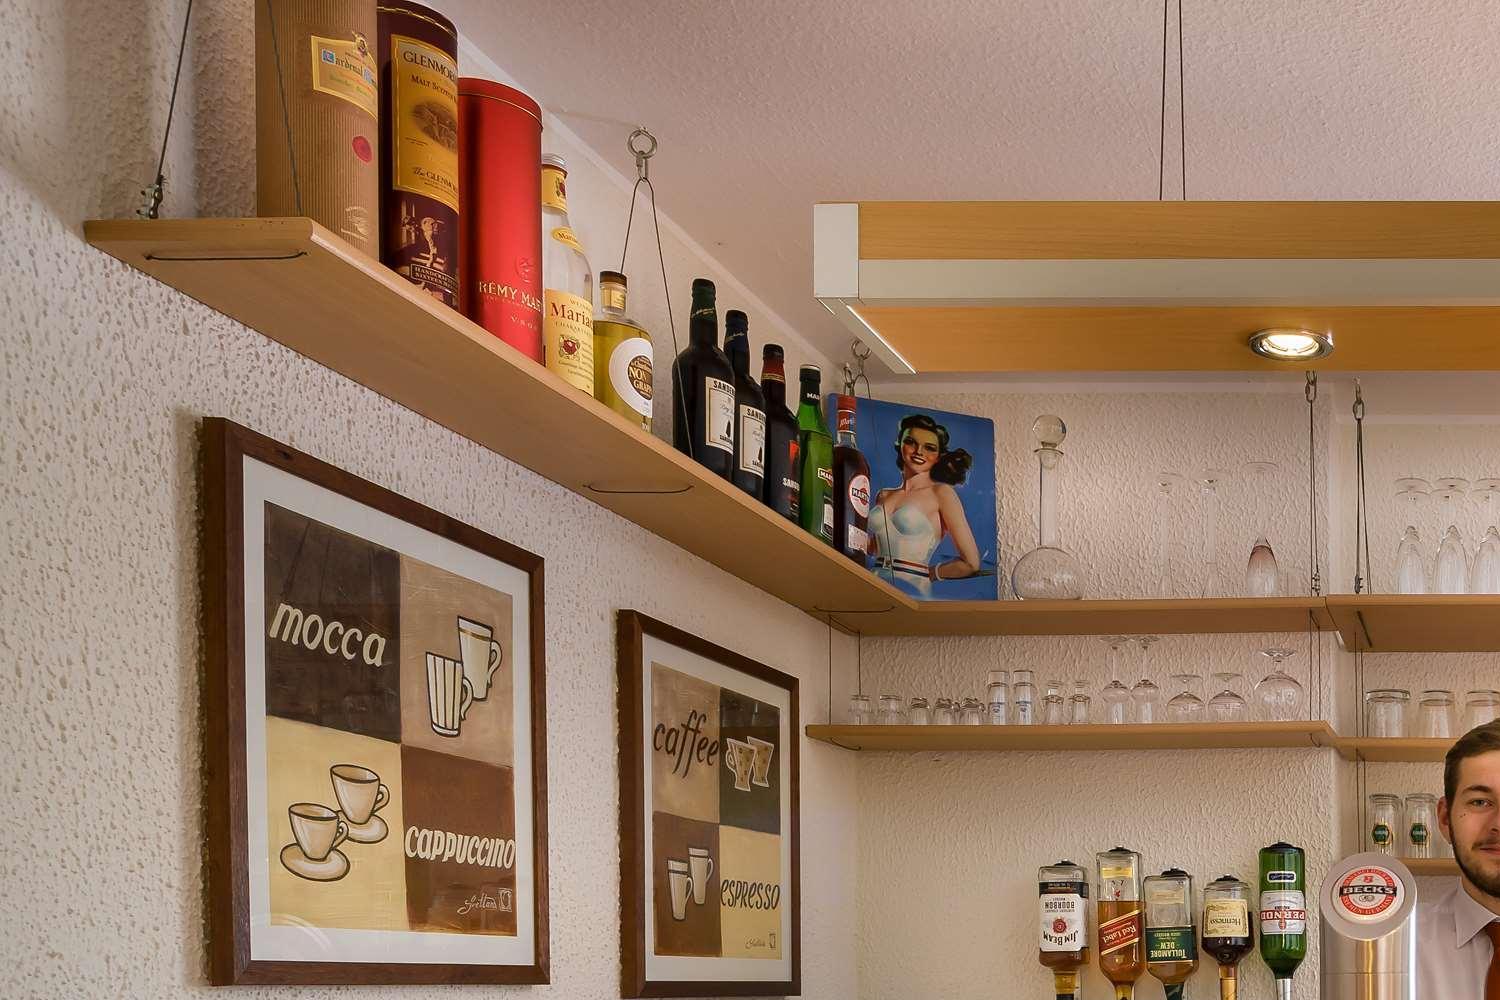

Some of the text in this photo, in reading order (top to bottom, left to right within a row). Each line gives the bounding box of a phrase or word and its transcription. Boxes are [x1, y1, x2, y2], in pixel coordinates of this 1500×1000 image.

[269, 602, 386, 667] mocca
[653, 709, 720, 779] caffee
[404, 825, 516, 869] cappuccino
[1260, 911, 1305, 920] PERNOD
[1043, 930, 1063, 946] BEAM
[1121, 924, 1137, 937] Red
[1150, 949, 1187, 959] TULLAMORE
